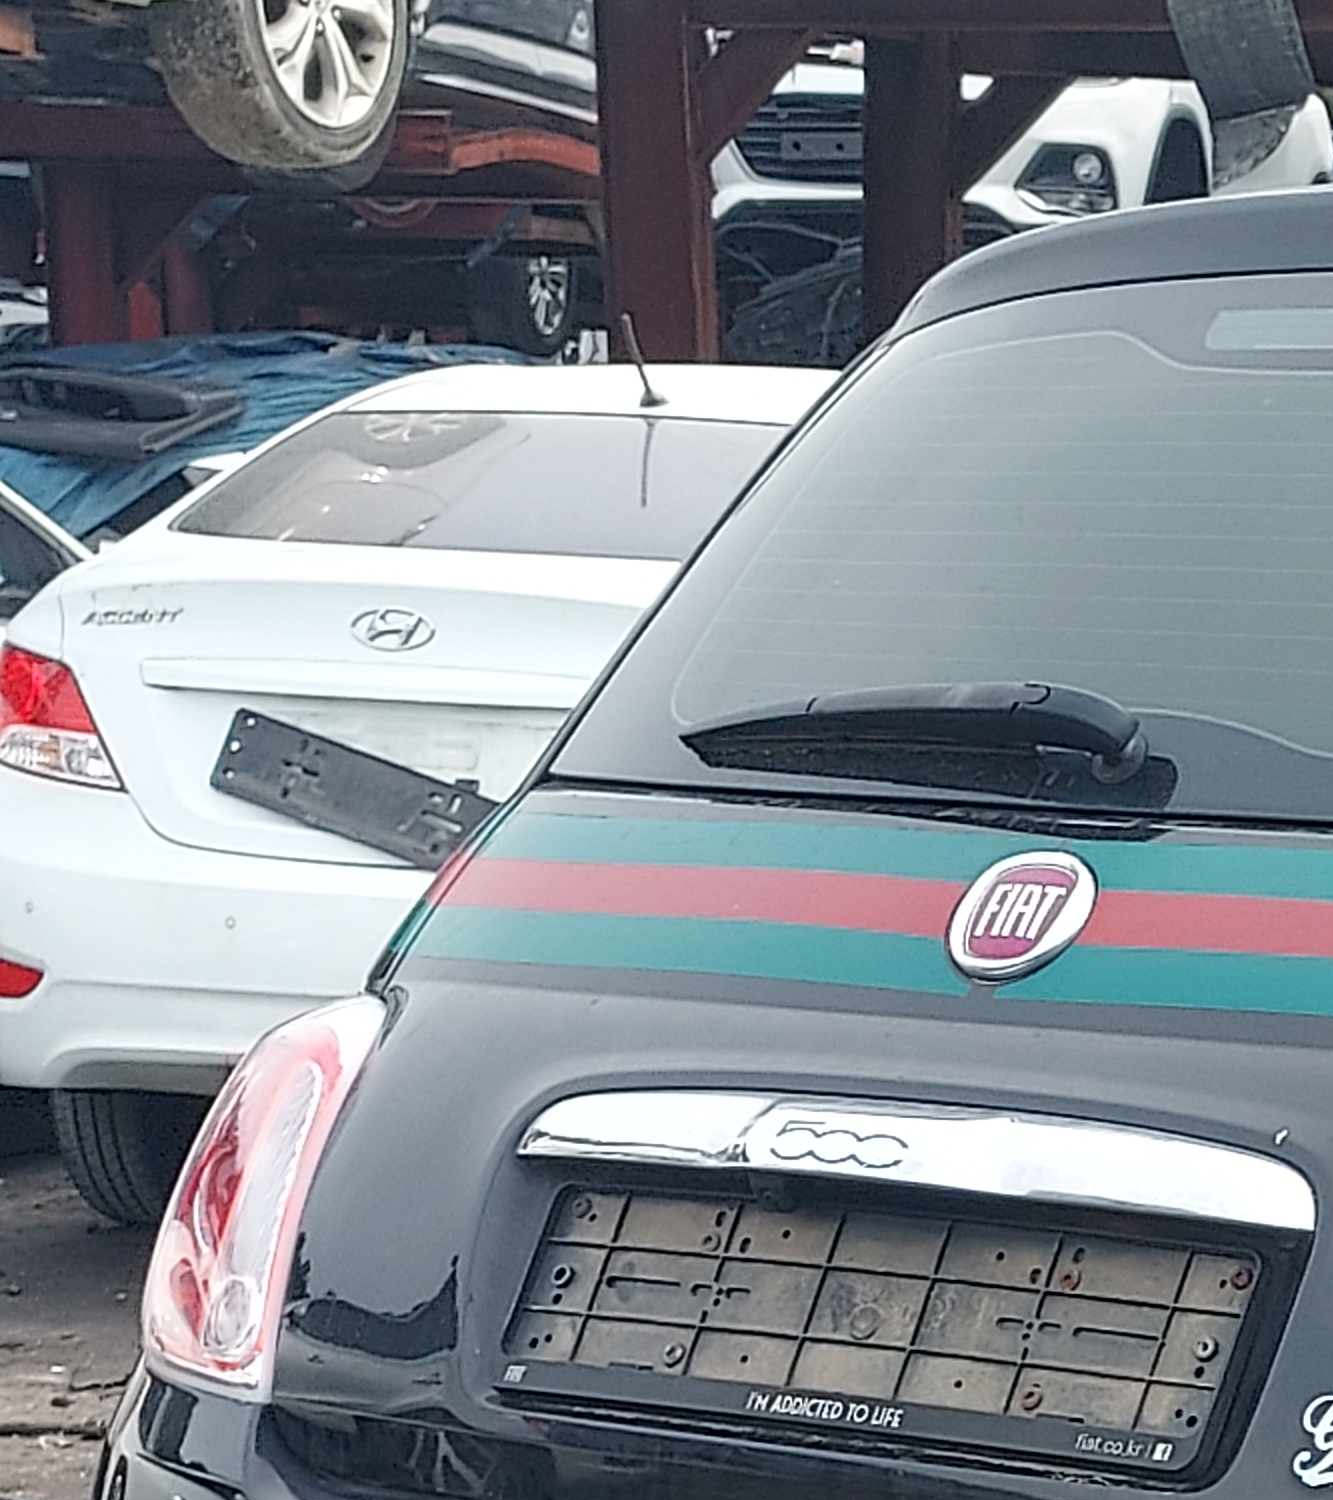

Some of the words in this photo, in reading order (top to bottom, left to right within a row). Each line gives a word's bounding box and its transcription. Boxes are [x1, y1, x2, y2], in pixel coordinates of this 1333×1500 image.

[973, 882, 1067, 941] FIAT
[770, 1119, 909, 1169] 500
[769, 1394, 844, 1420] ADDICTED
[845, 1402, 869, 1424] TO
[870, 1405, 904, 1428] LIFE
